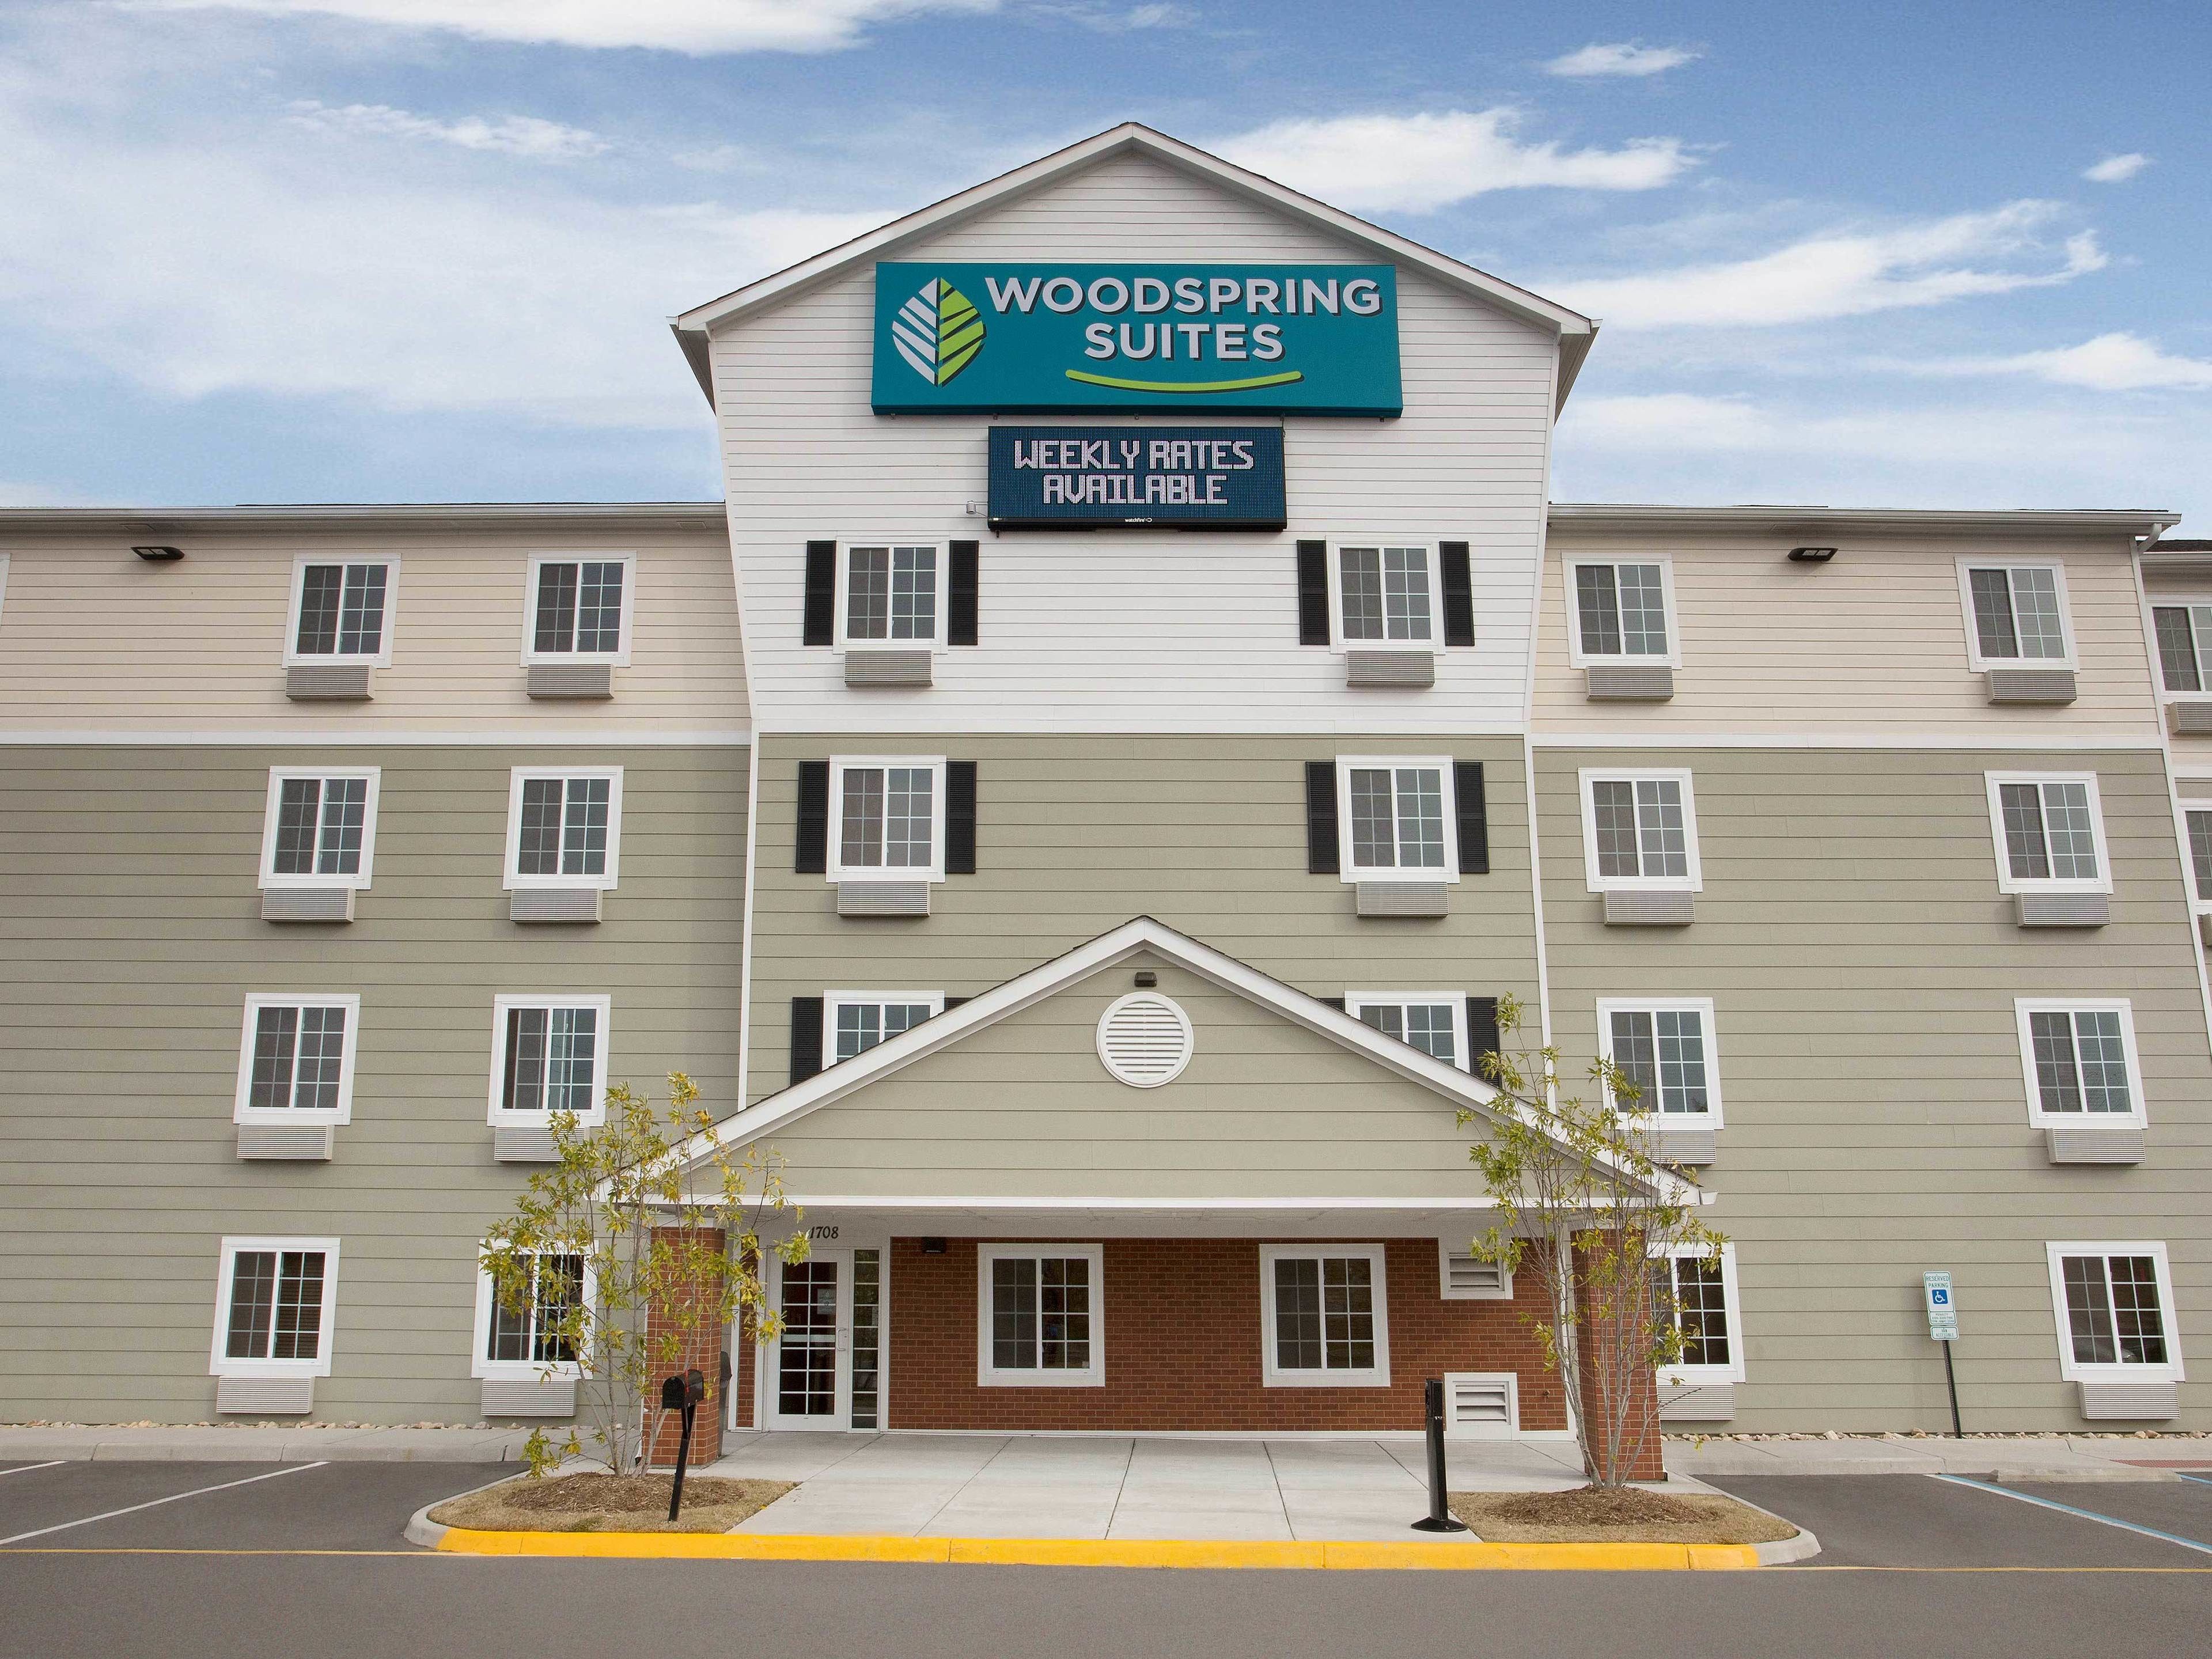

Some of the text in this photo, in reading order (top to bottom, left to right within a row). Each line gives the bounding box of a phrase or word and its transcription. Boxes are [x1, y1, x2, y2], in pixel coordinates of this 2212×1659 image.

[984, 277, 1382, 316] WOODSPRING
[1085, 323, 1286, 361] SUITES
[1014, 440, 1254, 471] WEEKLY RATES
[1043, 475, 1228, 505] AVAILABLE
[809, 1226, 839, 1239] 1708
